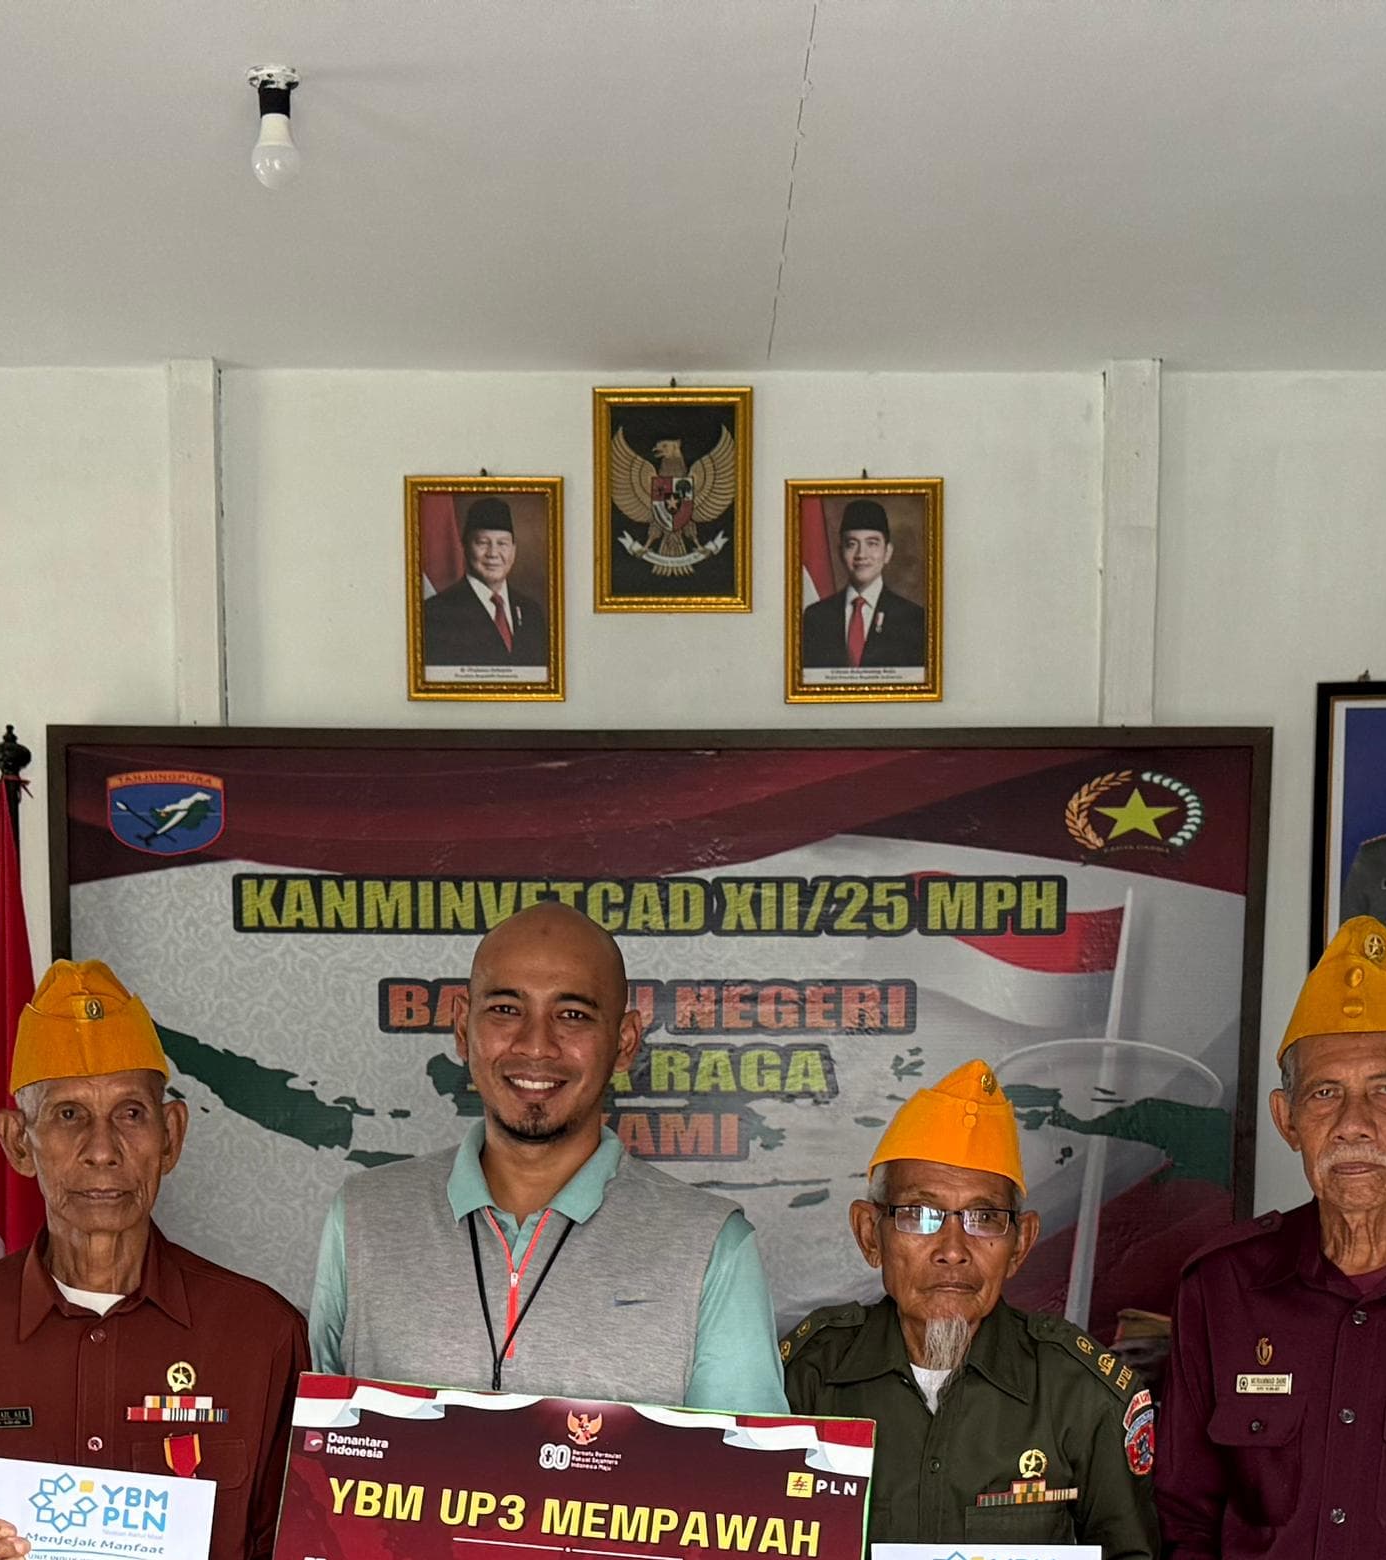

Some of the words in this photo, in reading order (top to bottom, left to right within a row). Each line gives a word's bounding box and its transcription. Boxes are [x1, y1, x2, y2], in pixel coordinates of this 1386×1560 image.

[721, 881, 910, 932] XII/25
[927, 881, 1059, 931] MPH
[674, 984, 906, 1029] NEGERI
[651, 1048, 829, 1093] RAGA
[326, 1443, 384, 1460] Indonesia
[327, 1432, 389, 1449] Danantara
[539, 1443, 571, 1470] 80
[101, 1483, 169, 1511] YBM
[816, 1479, 857, 1496] PLN
[102, 1506, 167, 1533] PLN
[329, 1477, 424, 1522] YBM
[439, 1488, 526, 1531] UP3
[540, 1498, 821, 1558] MEMPAWAH
[24, 1530, 97, 1549] Menjejak
[100, 1538, 166, 1555] Manfaat
